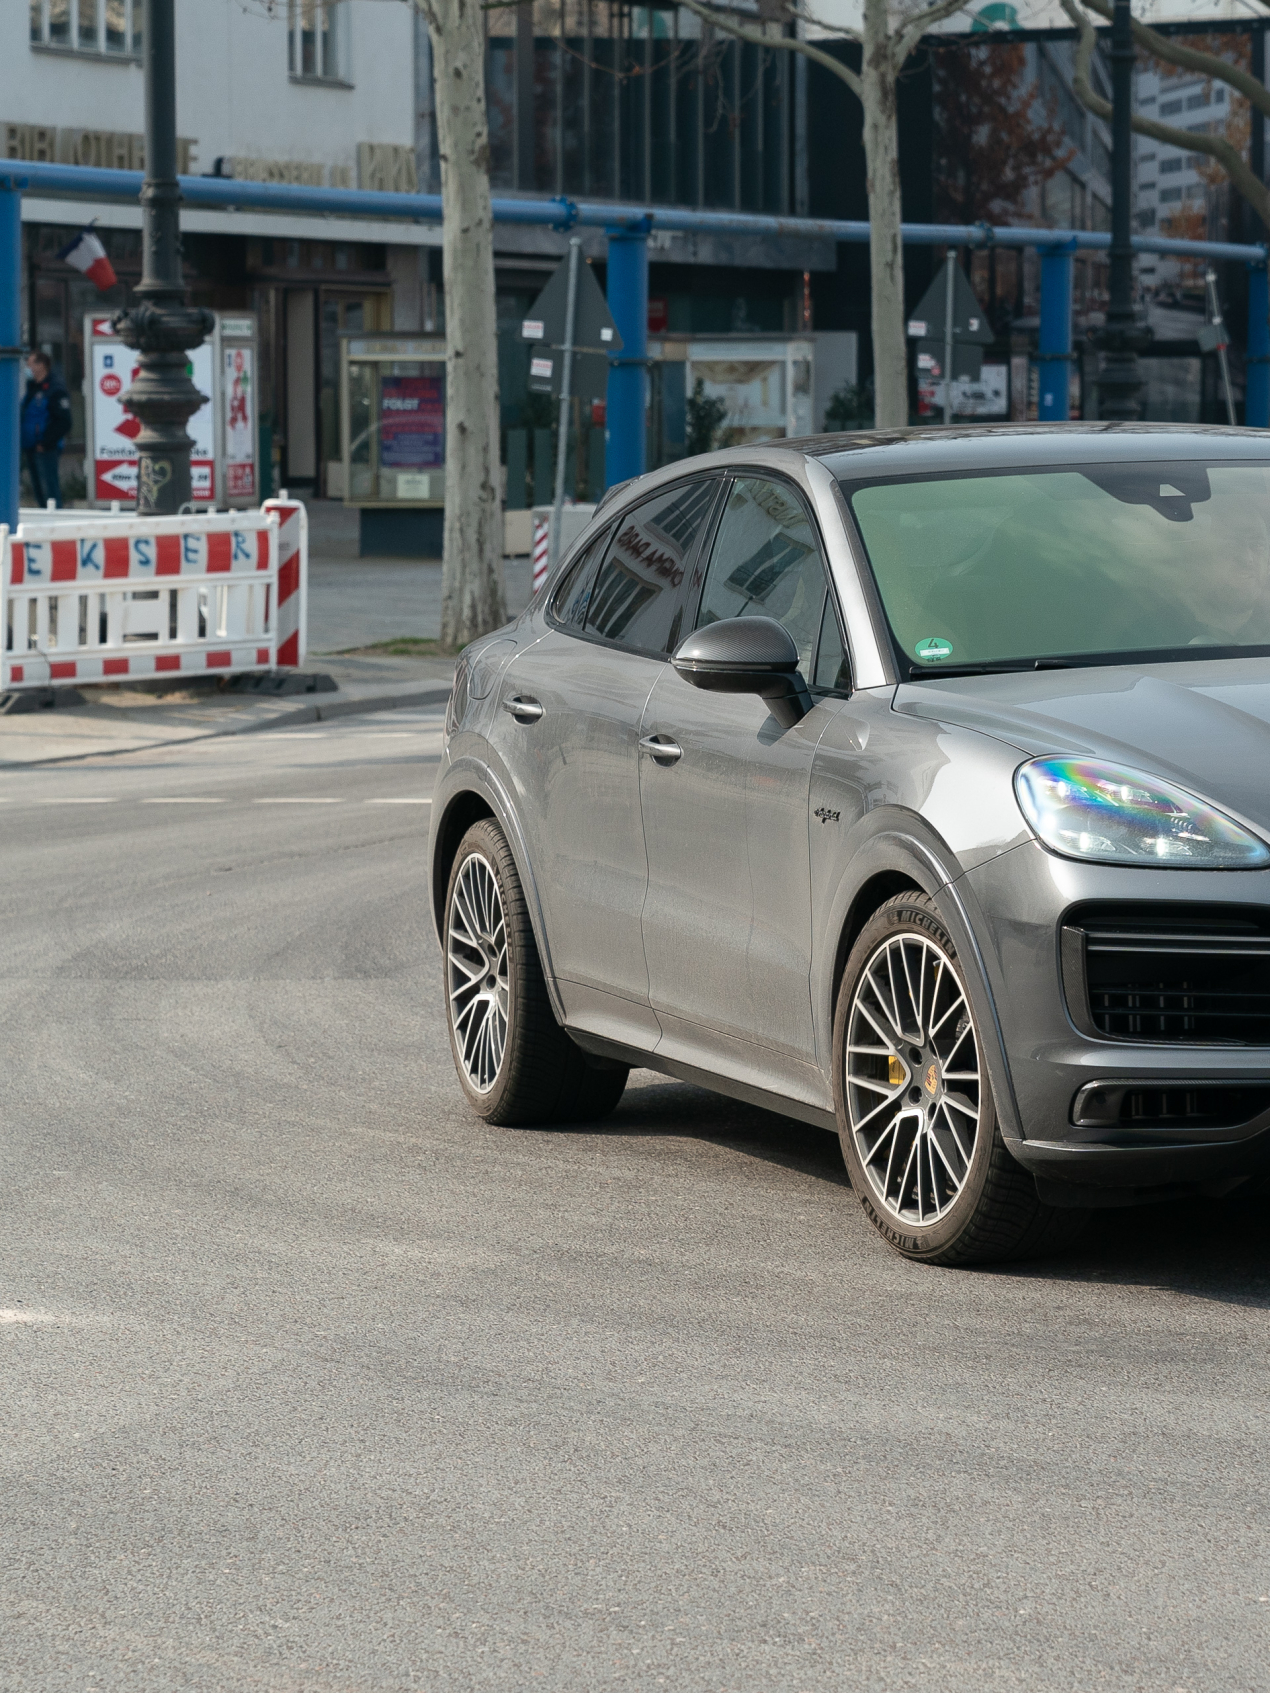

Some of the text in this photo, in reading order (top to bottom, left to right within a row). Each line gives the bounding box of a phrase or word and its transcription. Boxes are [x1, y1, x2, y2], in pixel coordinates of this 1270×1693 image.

[382, 397, 420, 411] FOLGT
[928, 638, 939, 649] 4
[900, 910, 955, 957] MICHELIN
[863, 1199, 916, 1249] MICHELIN
